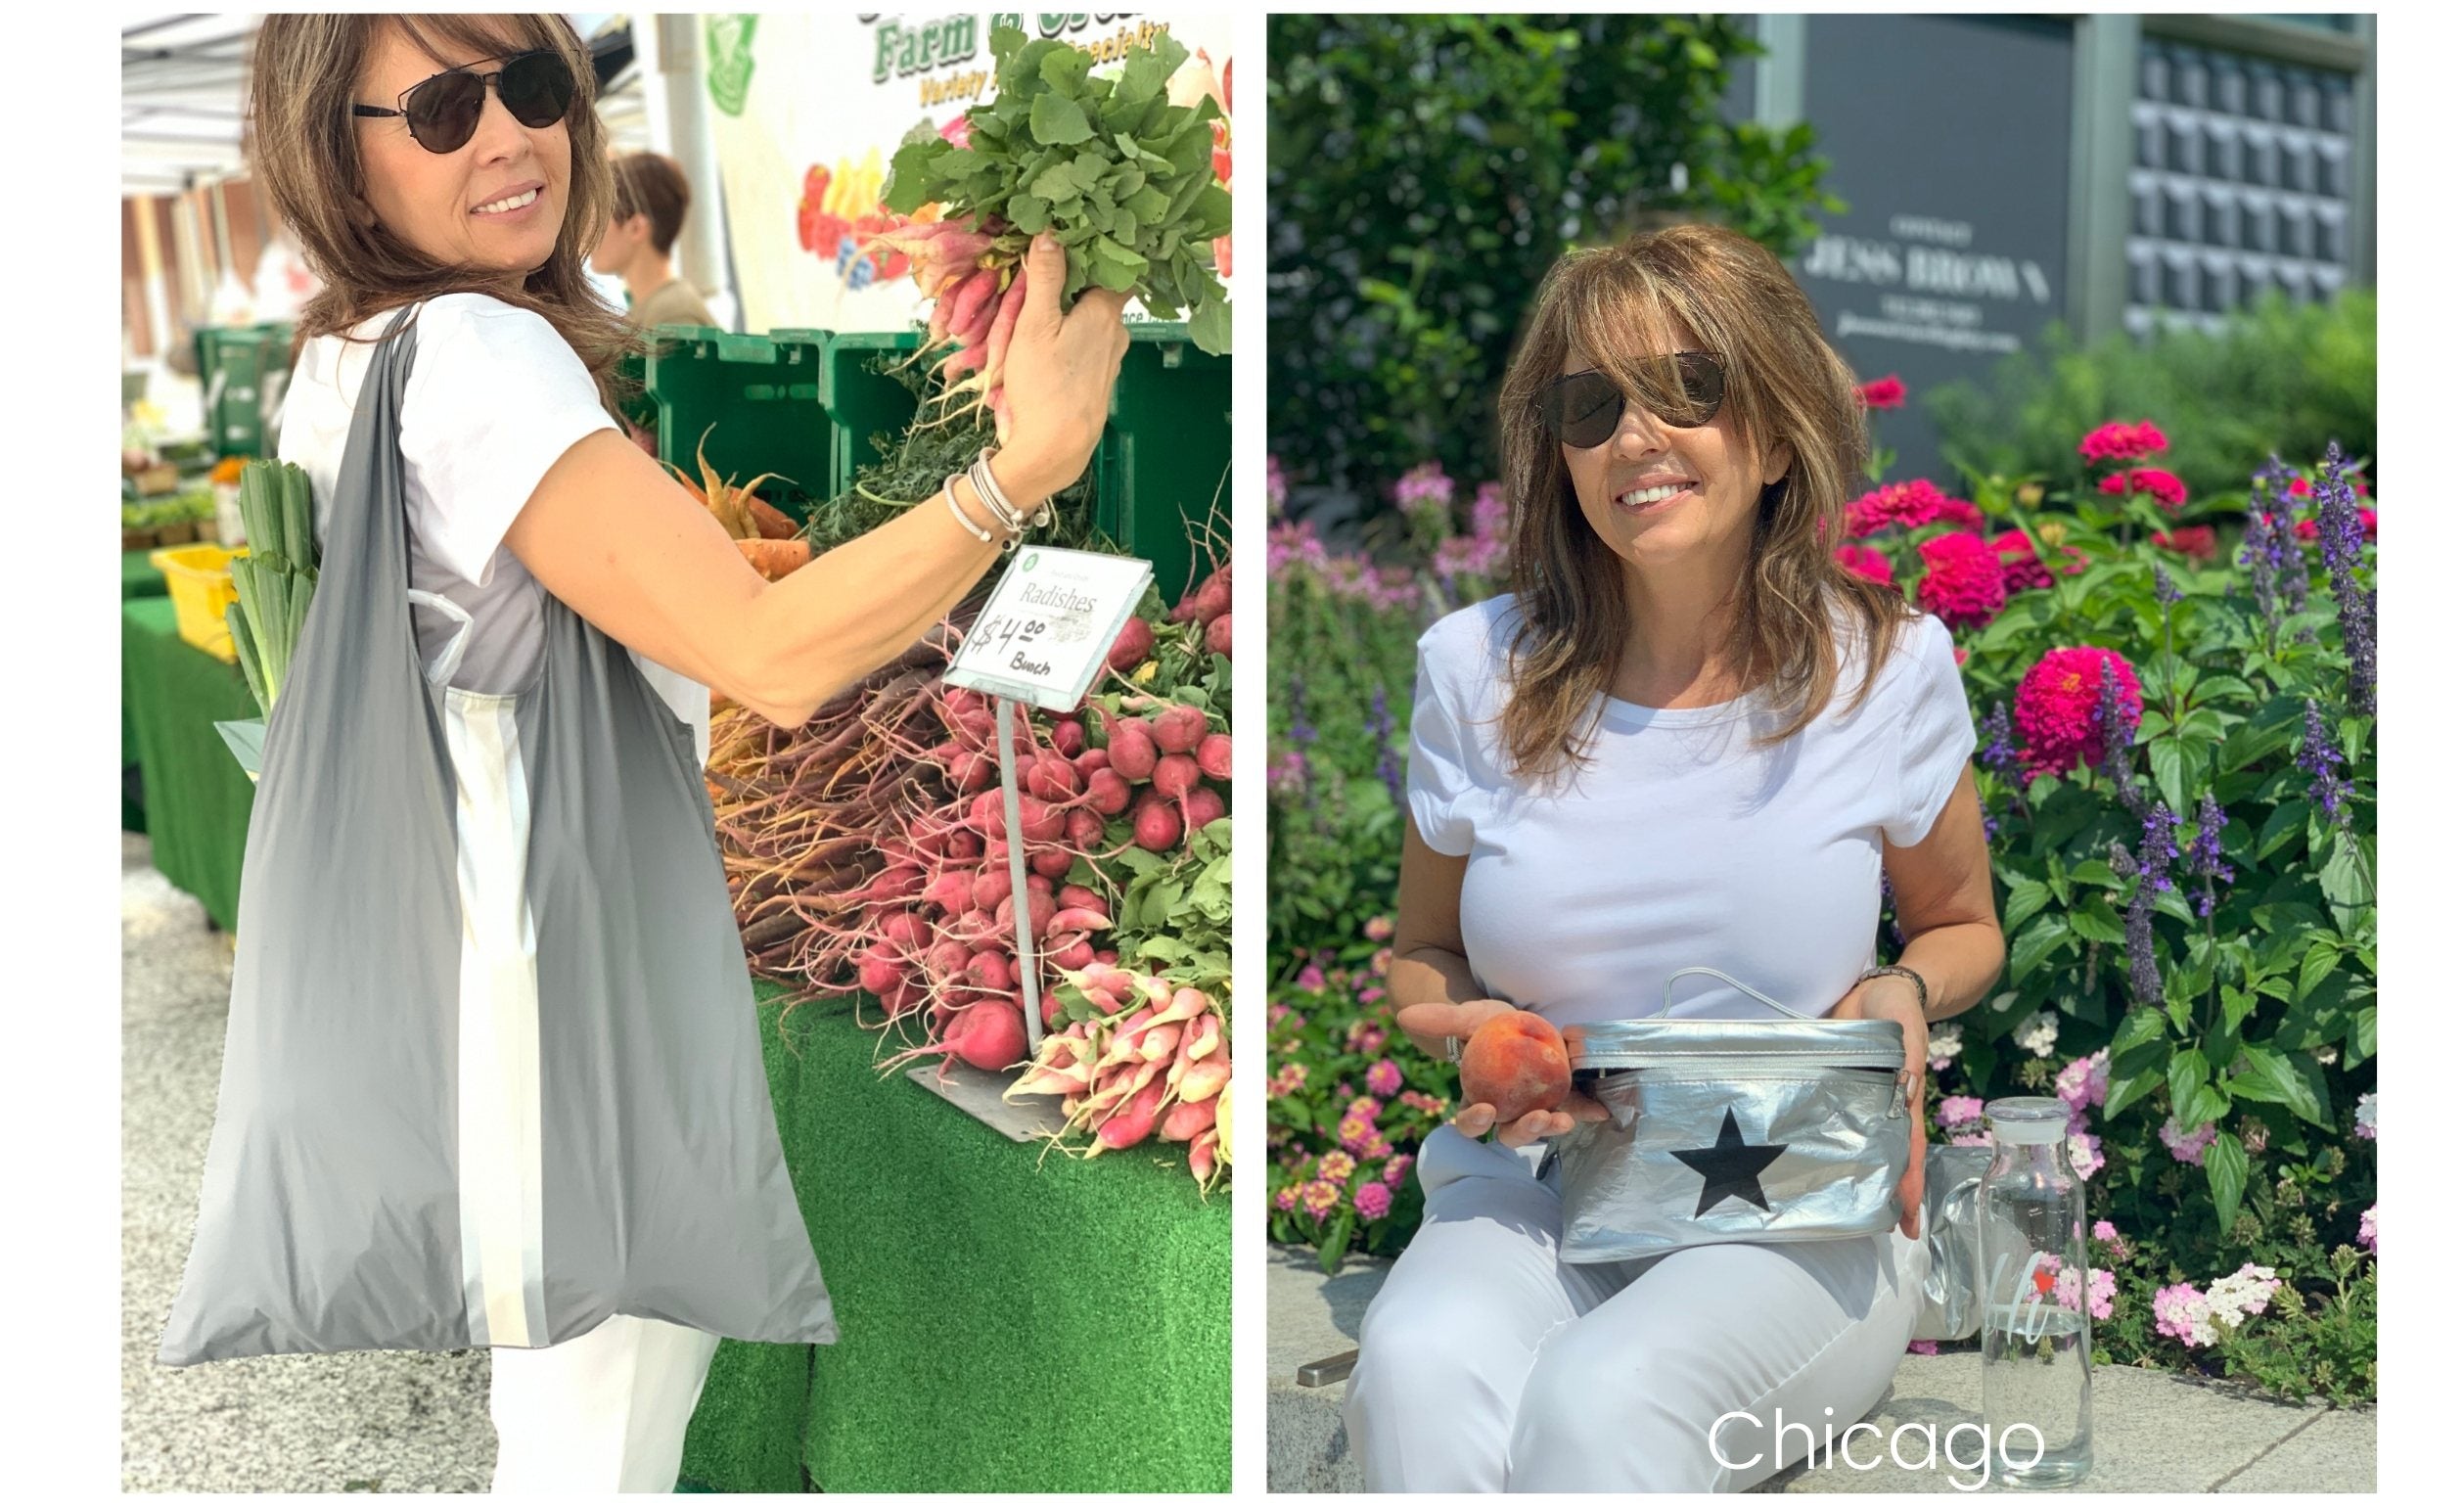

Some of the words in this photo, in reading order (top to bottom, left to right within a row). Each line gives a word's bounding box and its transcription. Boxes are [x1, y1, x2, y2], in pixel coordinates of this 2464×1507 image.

[874, 16, 977, 84] Farm
[919, 69, 988, 108] Variety
[1068, 20, 1170, 67] ecialt
[1019, 581, 1098, 614] Radishes
[1009, 650, 1051, 676] Bunch
